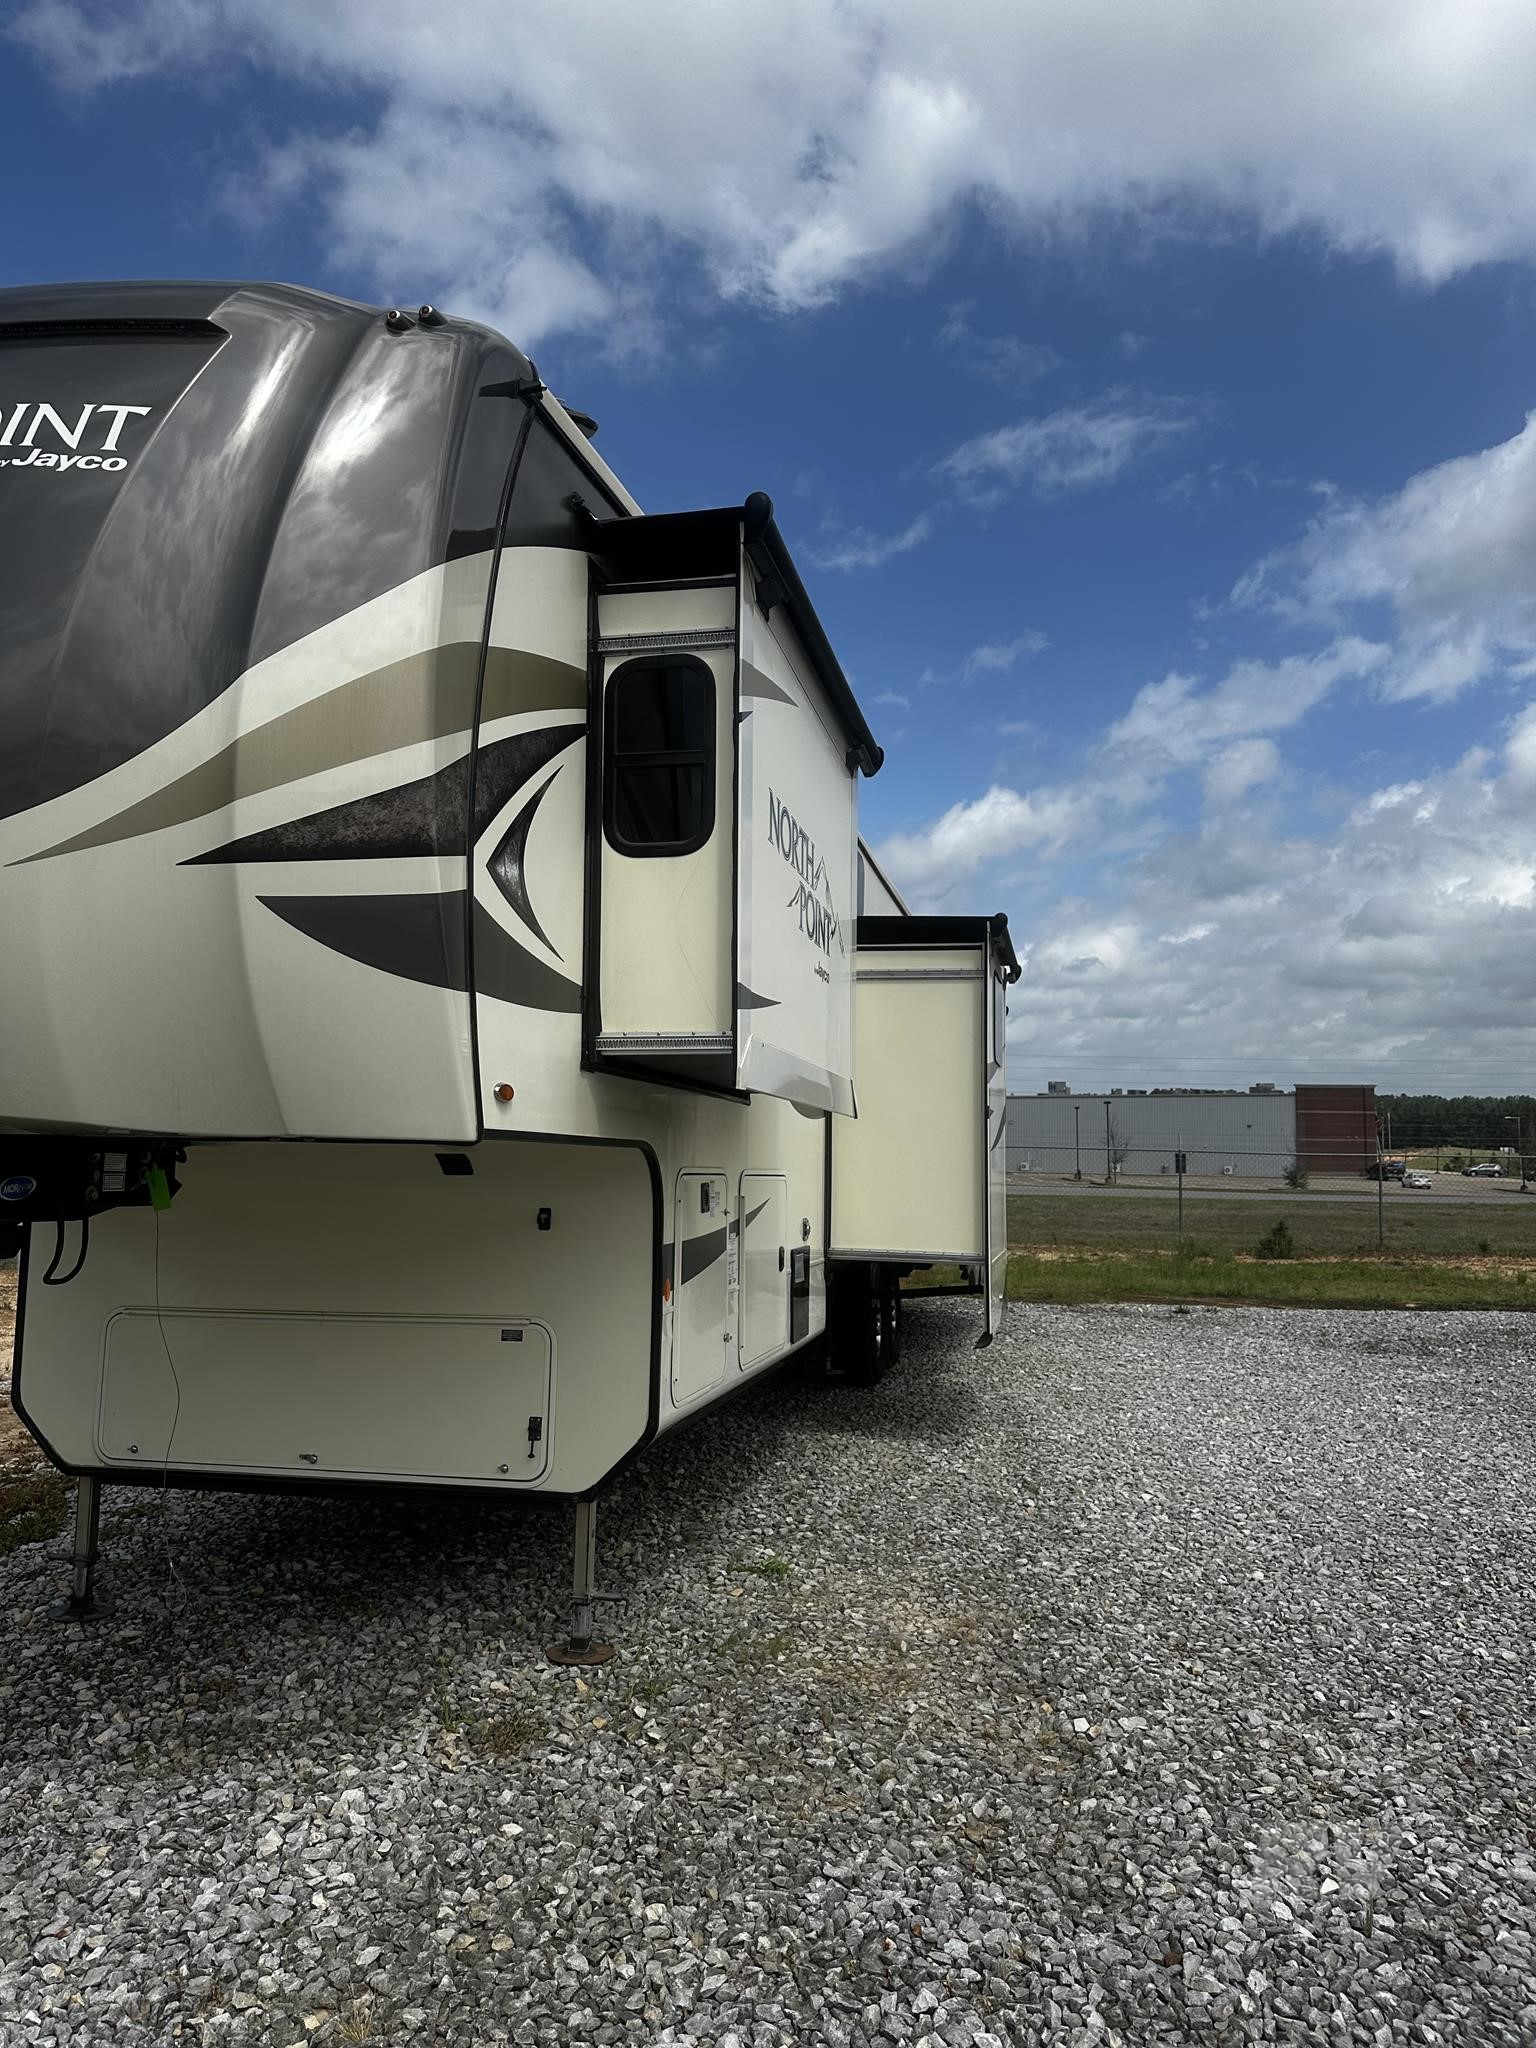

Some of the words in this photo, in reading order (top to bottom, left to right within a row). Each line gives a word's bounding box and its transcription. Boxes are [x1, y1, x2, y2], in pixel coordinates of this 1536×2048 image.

[0, 403, 152, 451] INT
[0, 459, 11, 467] y
[11, 448, 128, 471] Jayco
[767, 786, 816, 890] NORTH
[798, 880, 832, 957] POINT
